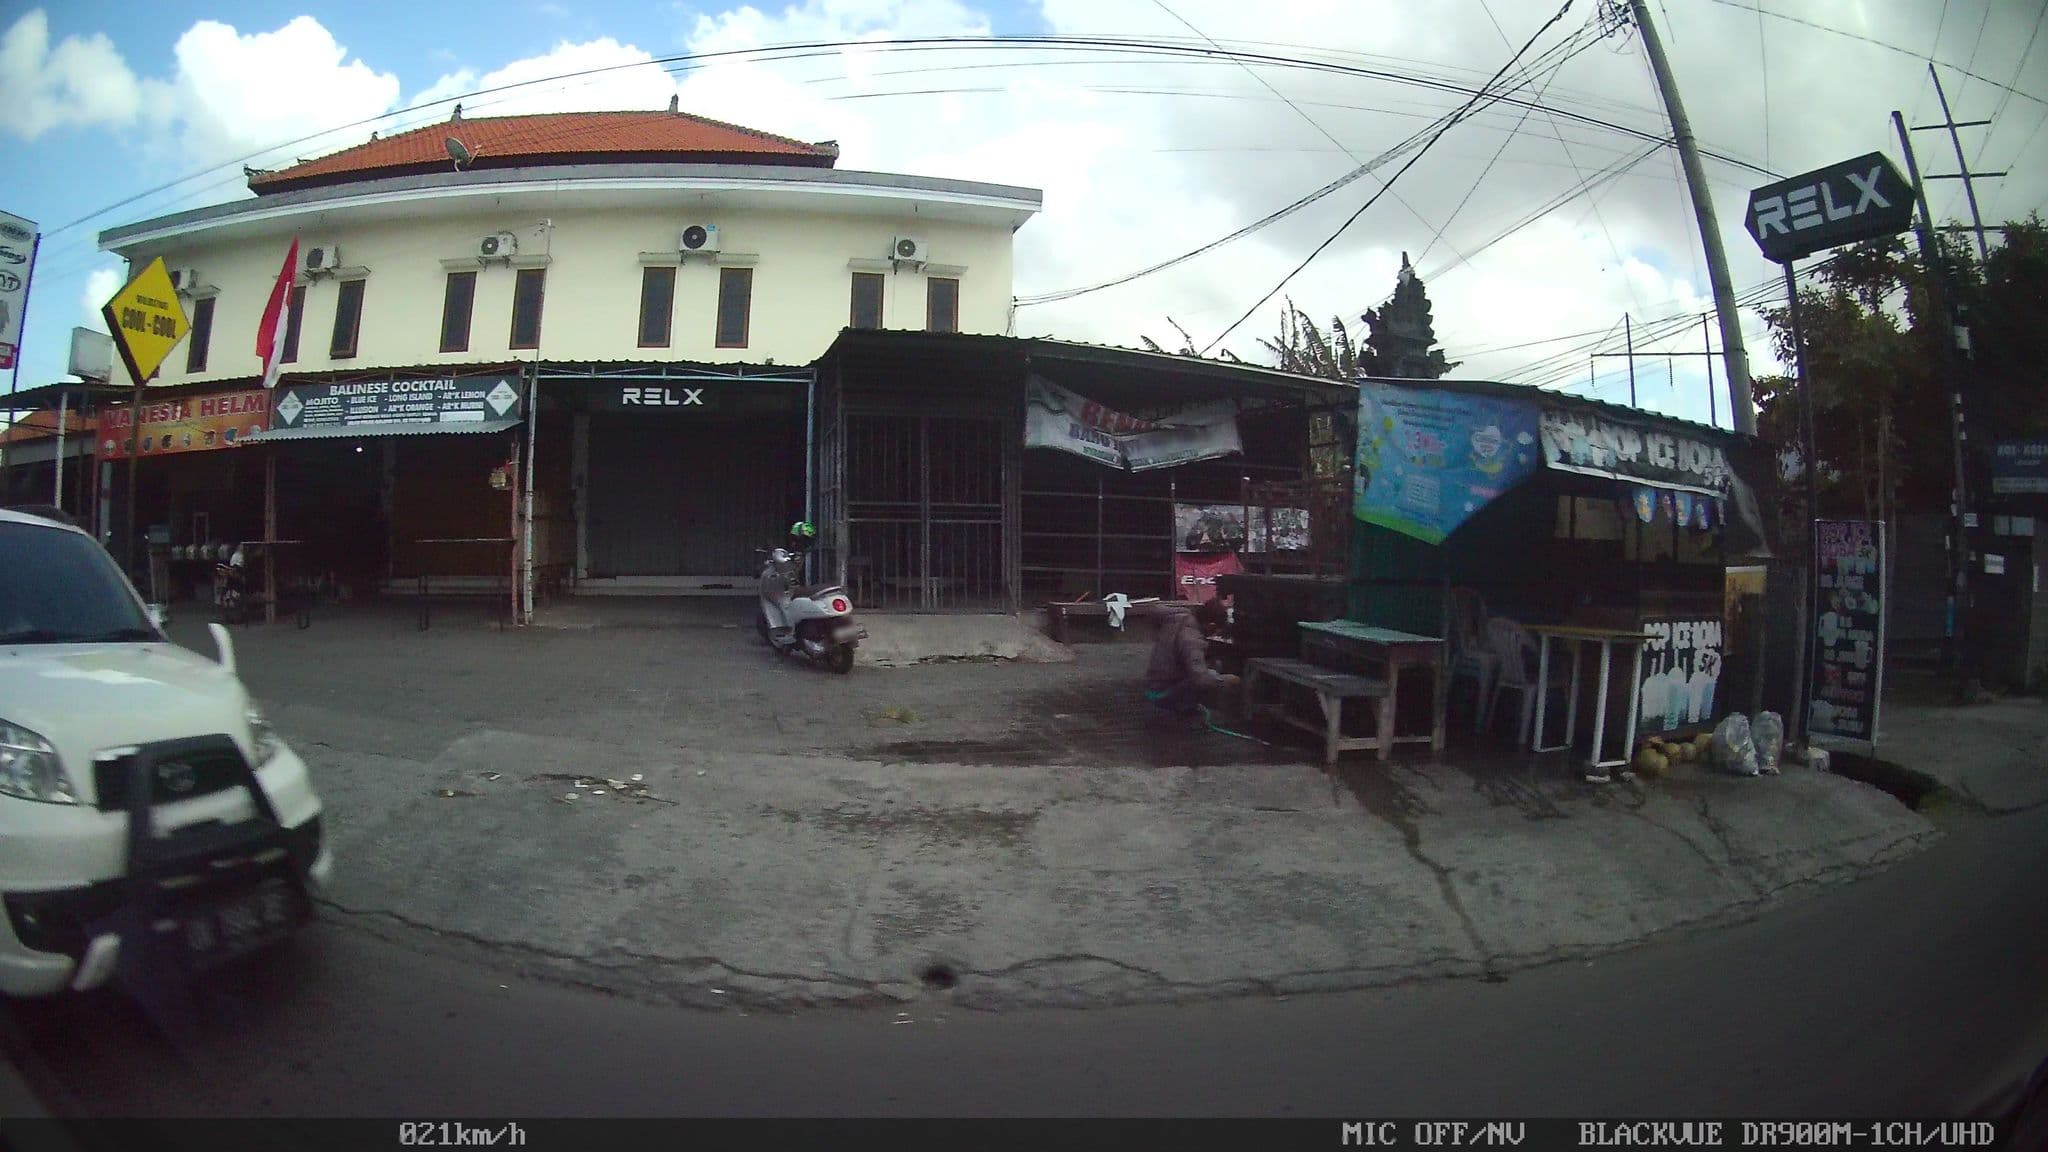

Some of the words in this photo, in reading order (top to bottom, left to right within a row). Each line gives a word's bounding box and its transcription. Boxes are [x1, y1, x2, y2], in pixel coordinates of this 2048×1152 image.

[1753, 165, 1891, 240] RELX
[330, 382, 388, 396] BALINESE
[392, 379, 456, 393] COCKTAIL
[350, 396, 366, 404] BLUE
[367, 395, 377, 403] ICE
[388, 394, 408, 402] LONG
[409, 392, 433, 401] ISLAND
[461, 391, 486, 399] LEMON
[622, 387, 704, 405] RELX
[200, 393, 265, 418] HELM
[306, 397, 338, 406] MOJITO
[405, 403, 434, 412] ORANGE
